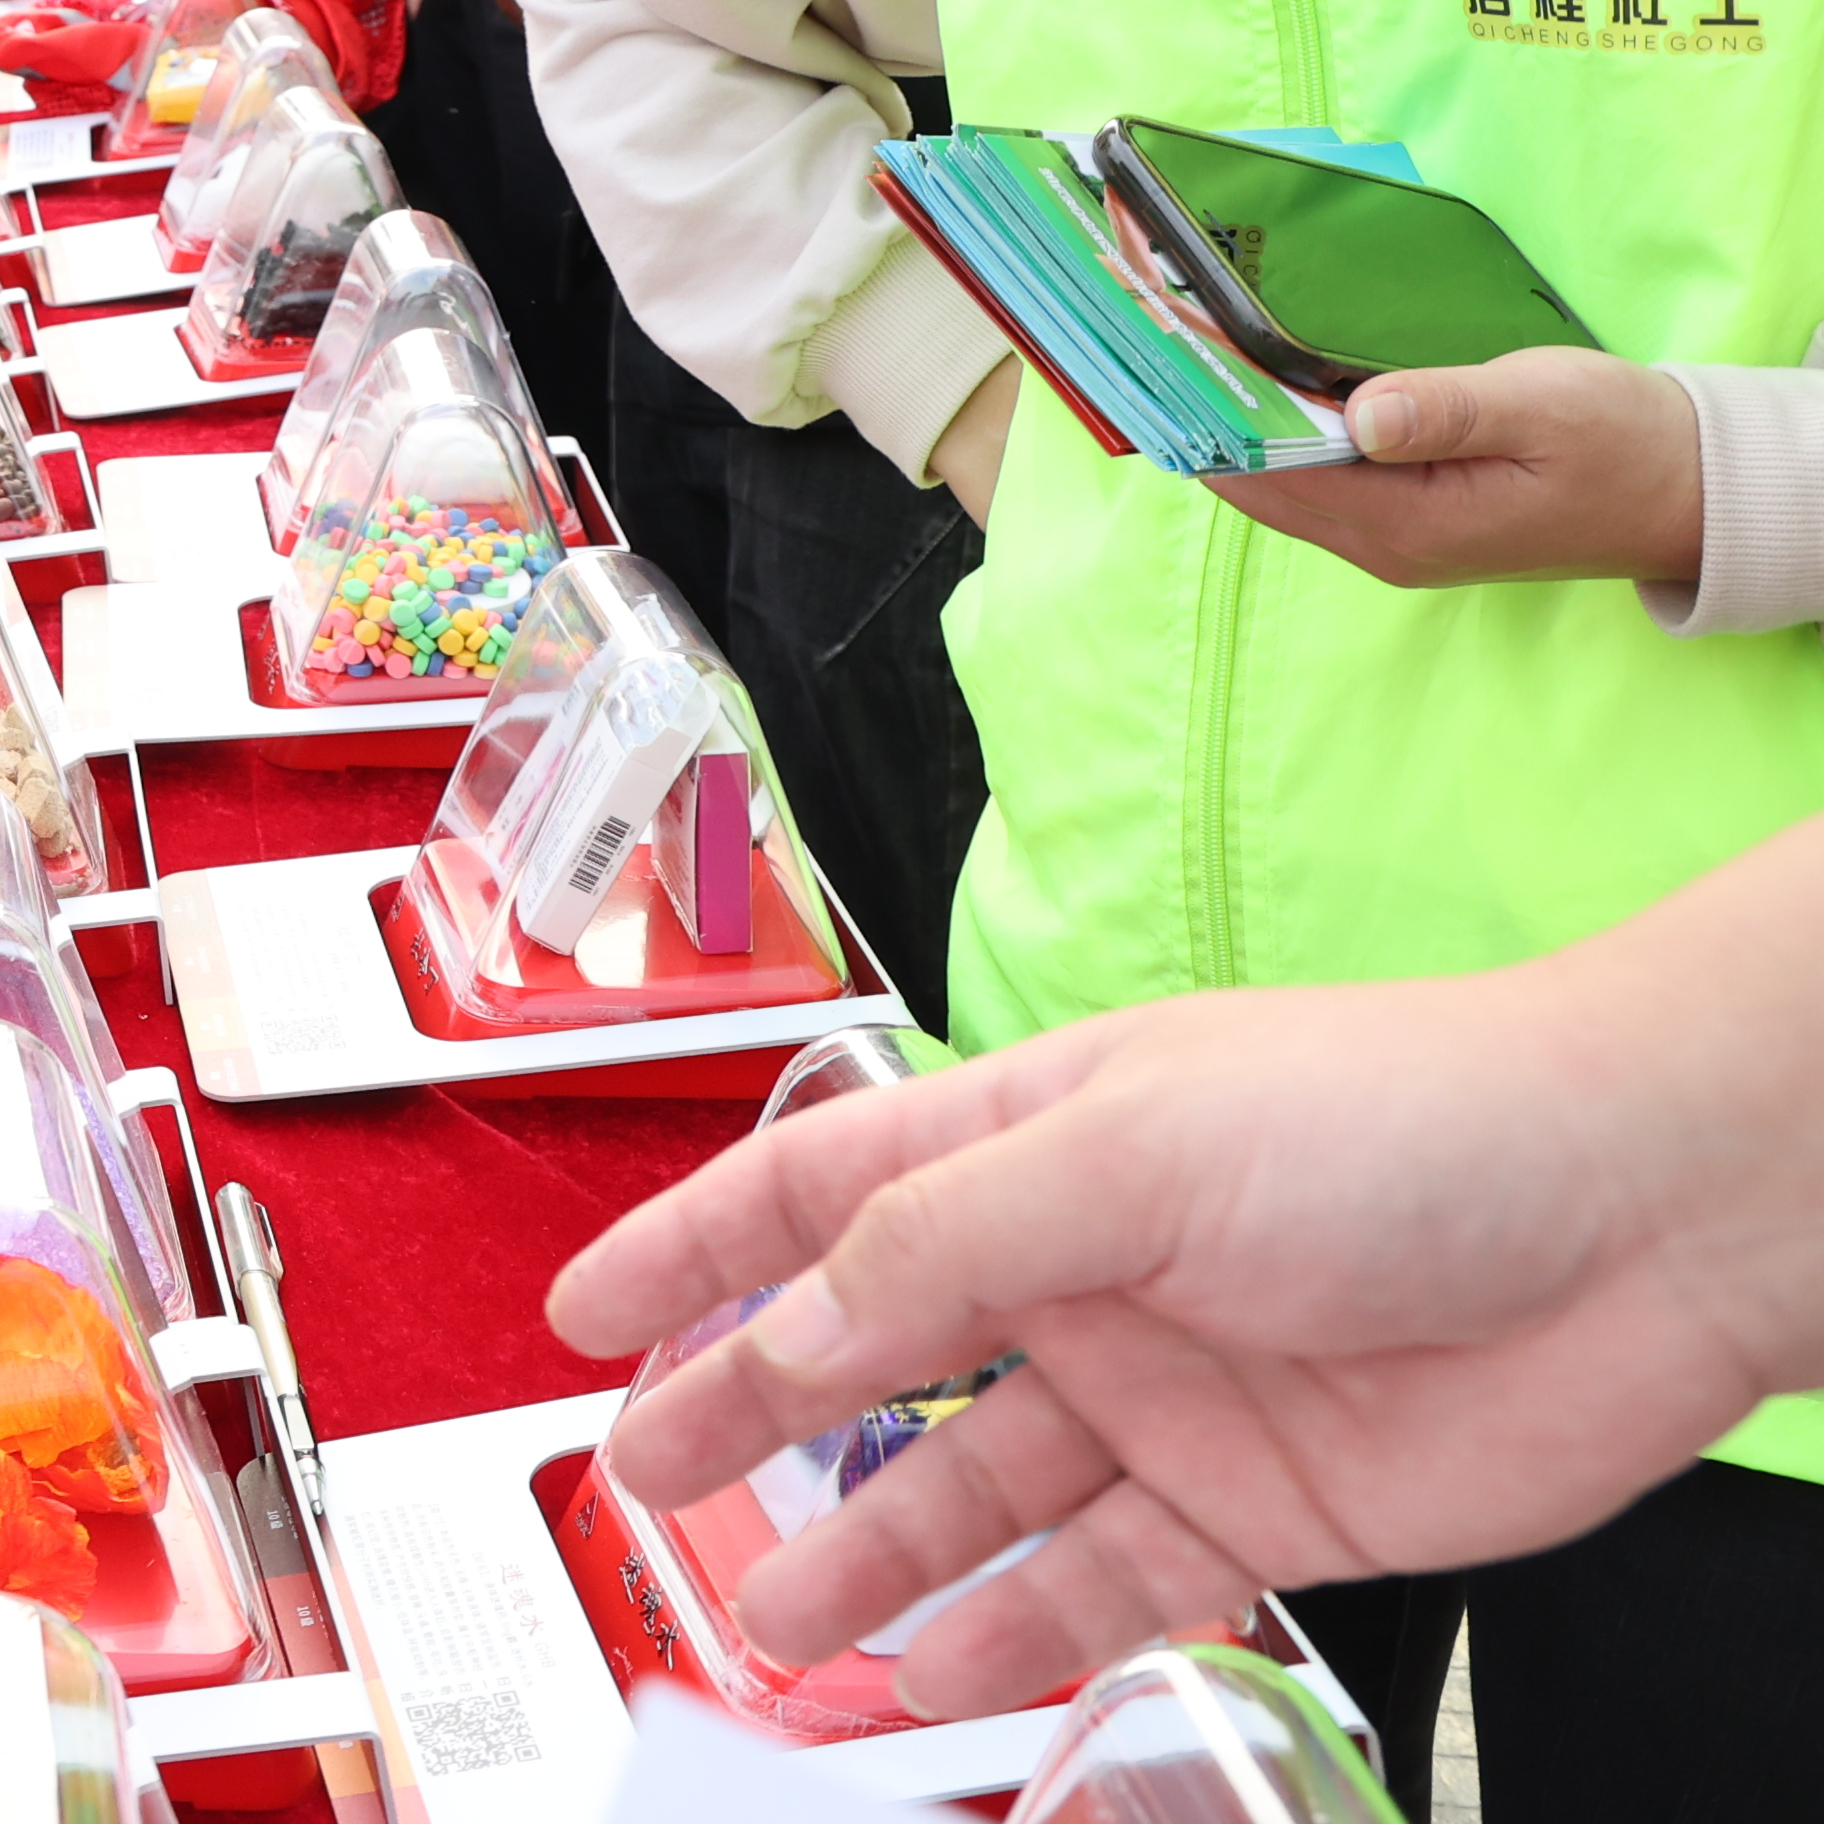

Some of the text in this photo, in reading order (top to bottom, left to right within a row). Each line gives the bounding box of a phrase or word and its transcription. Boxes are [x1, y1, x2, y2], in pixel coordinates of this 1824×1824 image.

[1472, 22, 1765, 53] QICHENG SHE GONG
[267, 1510, 283, 1530] 10级
[297, 1605, 315, 1628] 10级
[497, 1559, 556, 1669] 迷魂水 GHB
